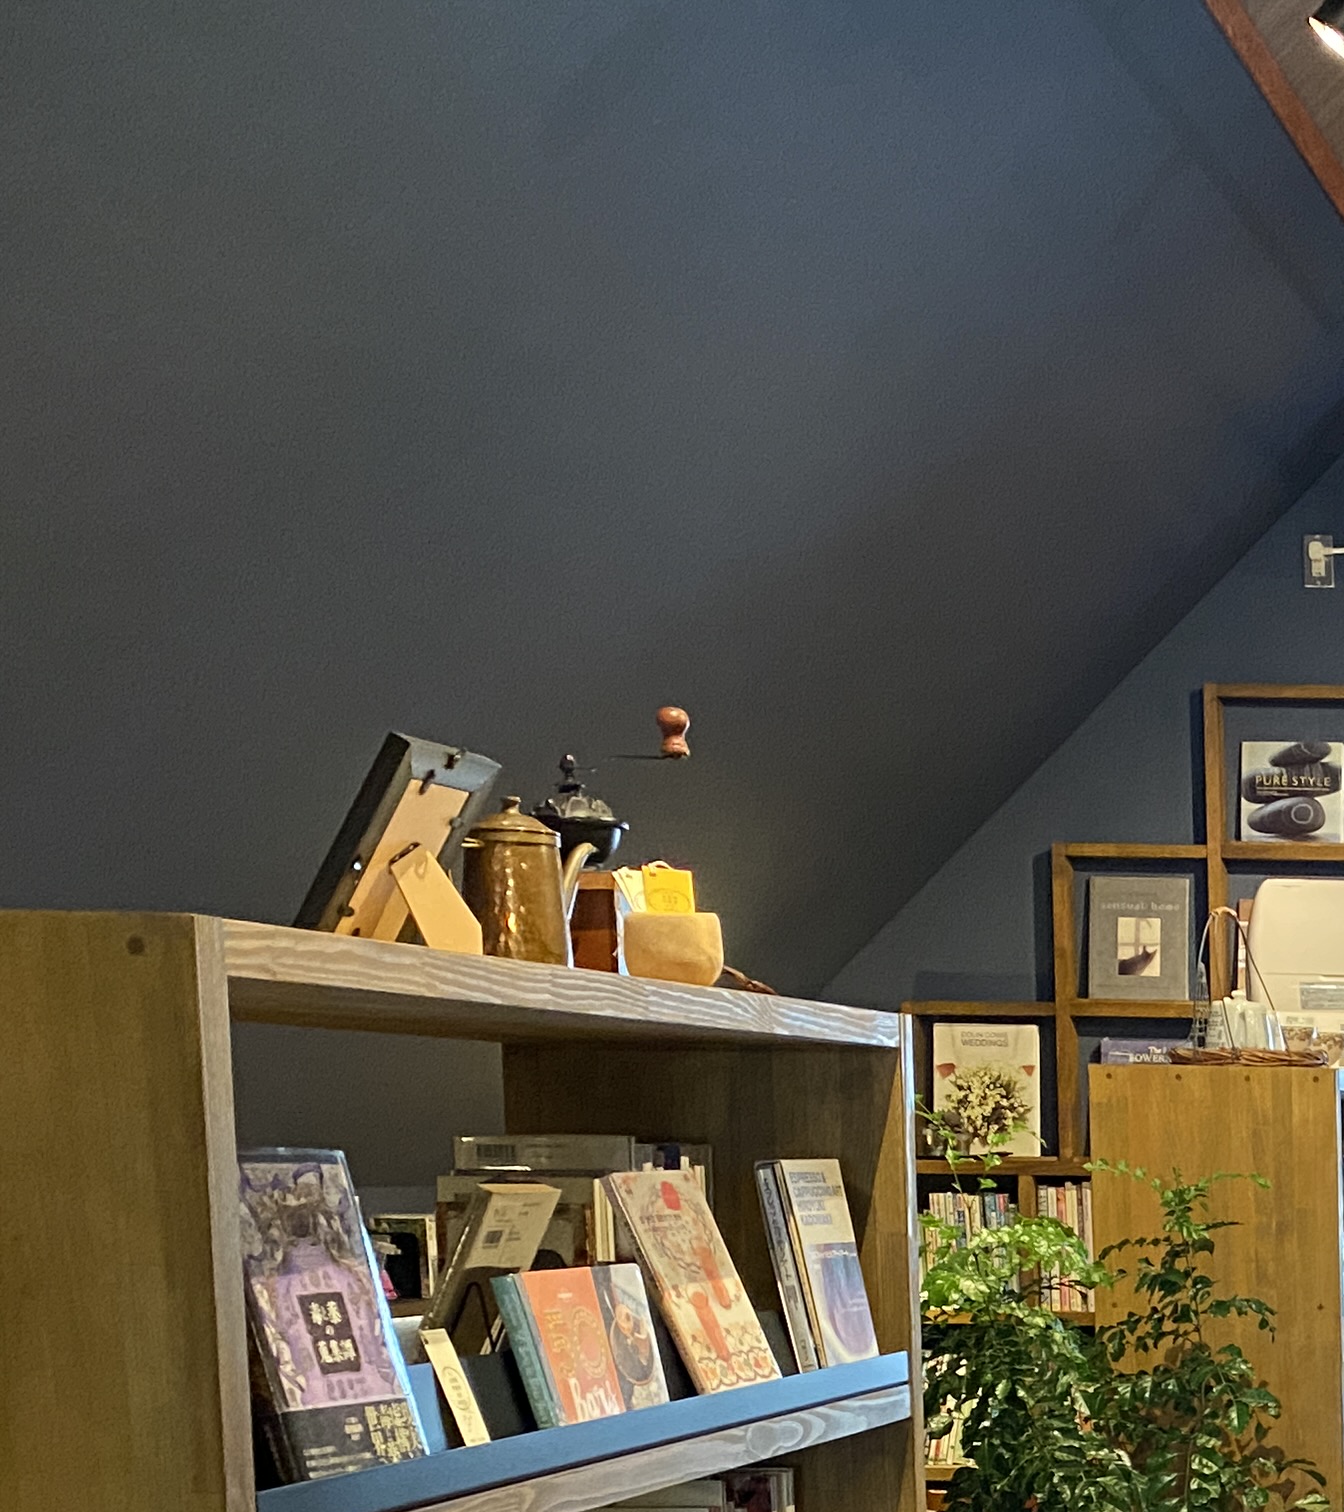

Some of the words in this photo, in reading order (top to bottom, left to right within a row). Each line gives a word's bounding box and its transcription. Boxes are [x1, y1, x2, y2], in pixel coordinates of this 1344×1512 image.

[1255, 775, 1288, 787] PURE
[1291, 776, 1331, 788] STYLE
[961, 1038, 1008, 1048] WEDDINGS
